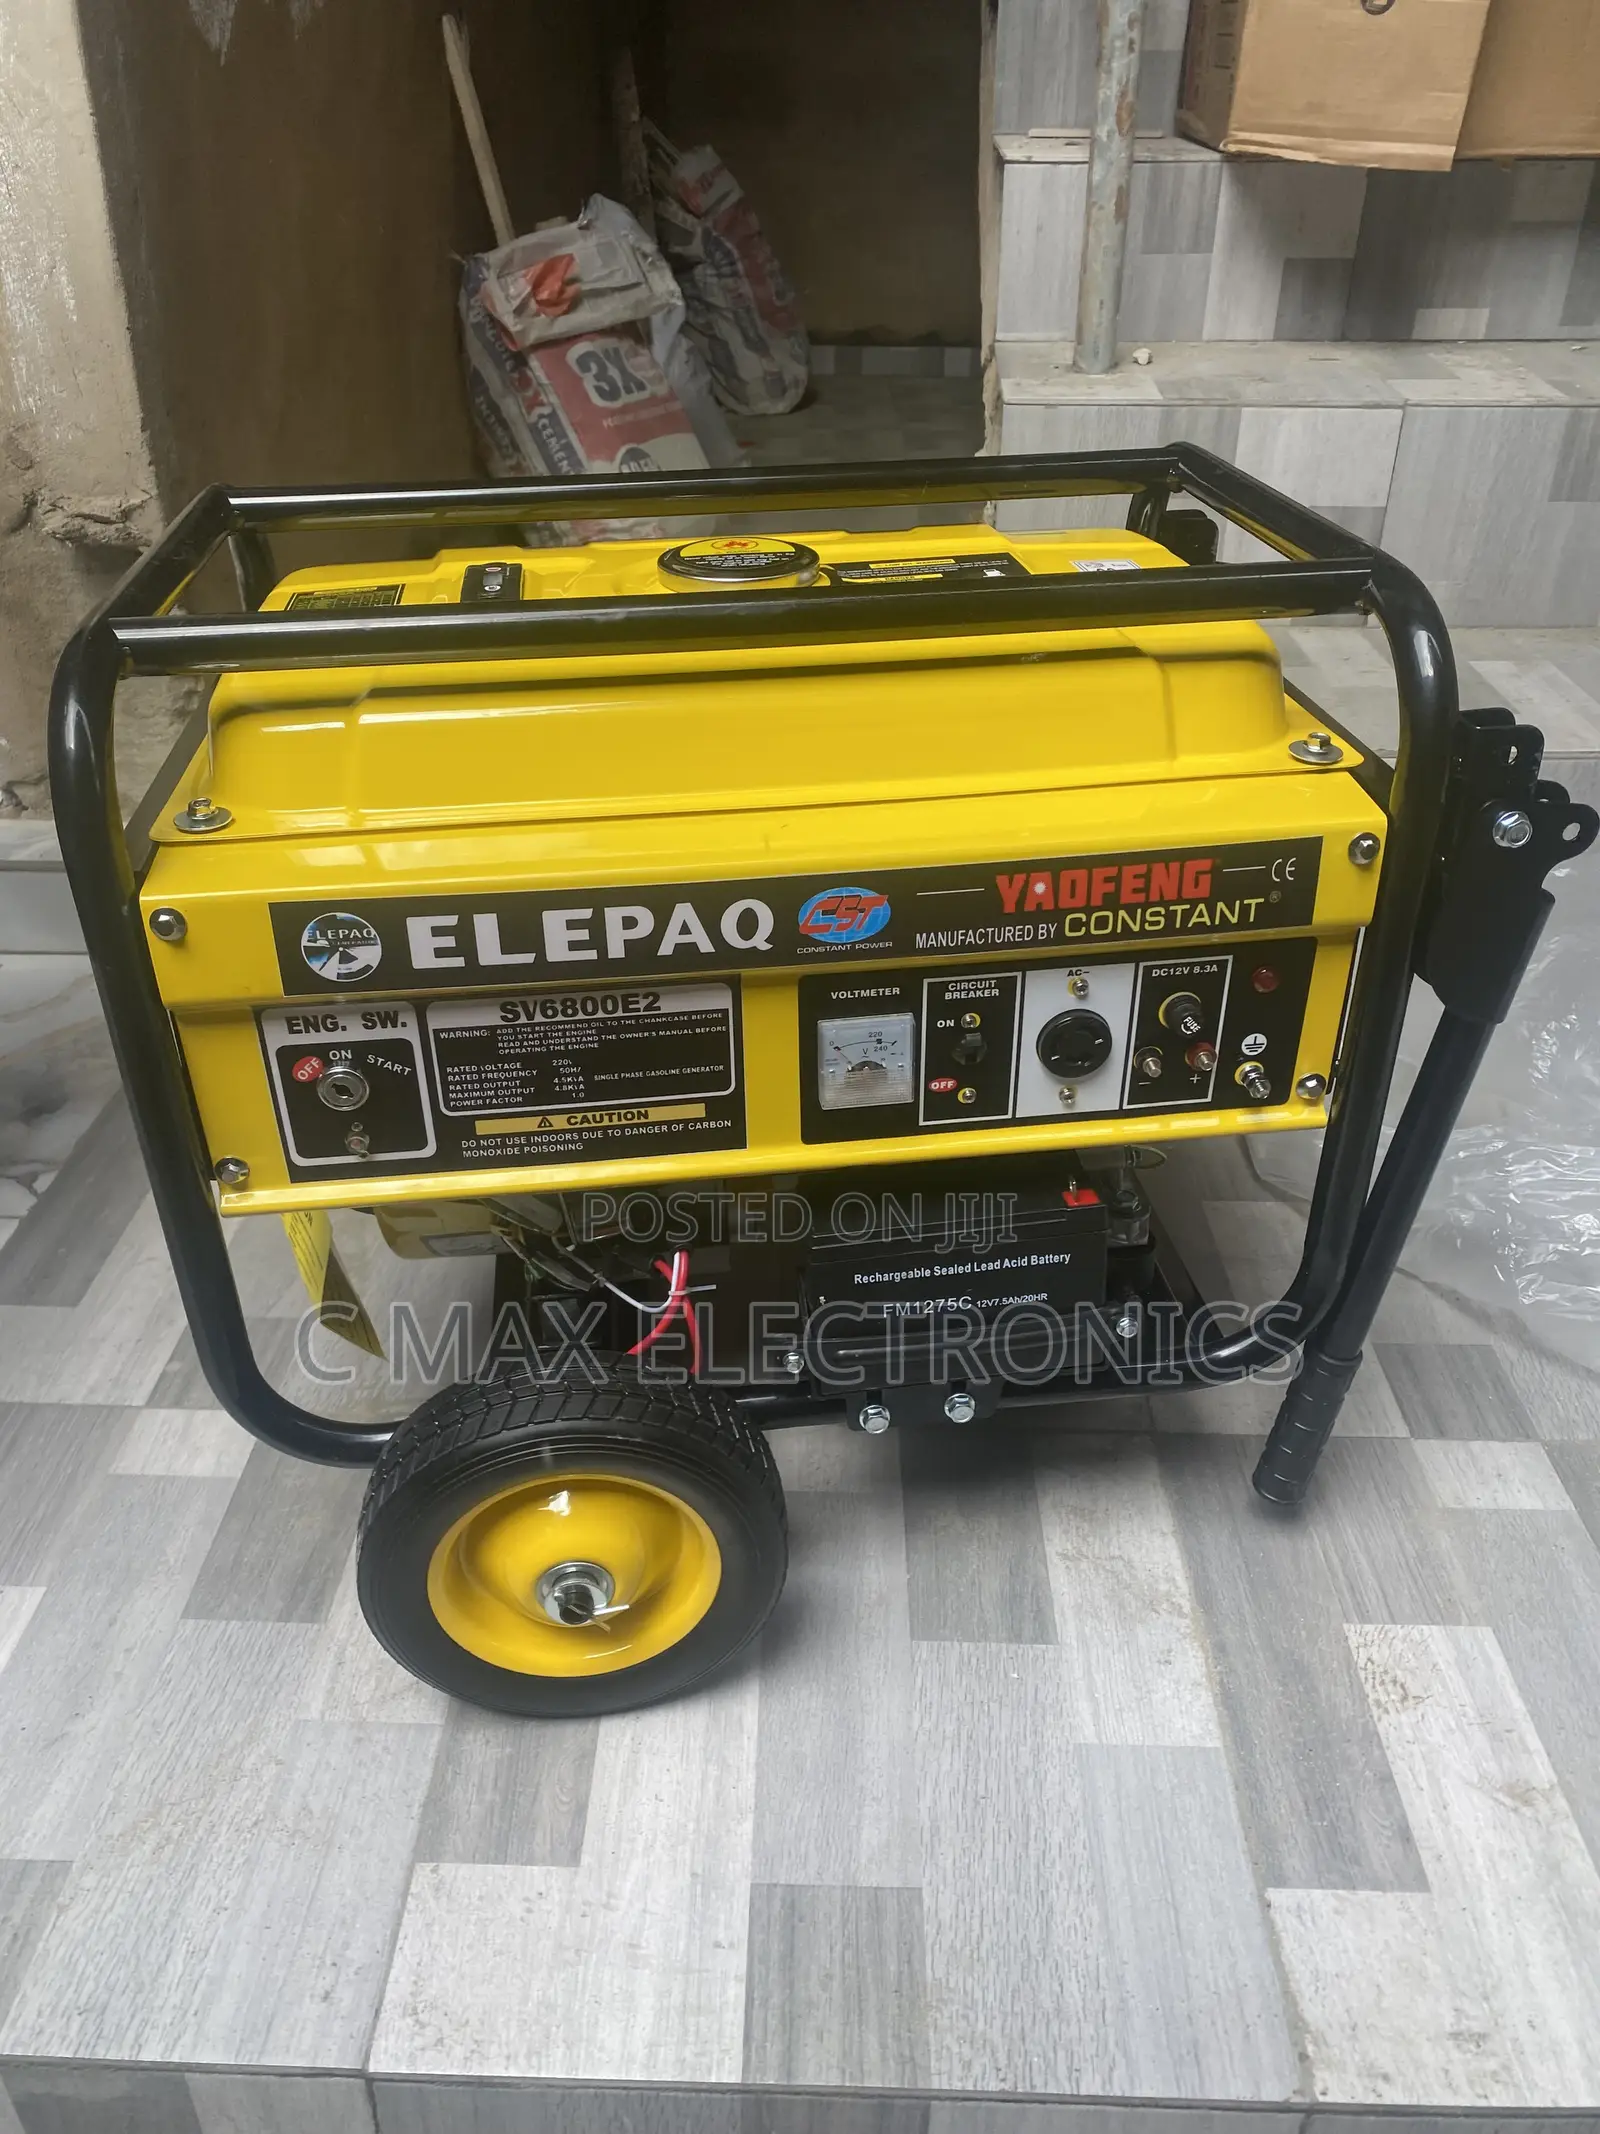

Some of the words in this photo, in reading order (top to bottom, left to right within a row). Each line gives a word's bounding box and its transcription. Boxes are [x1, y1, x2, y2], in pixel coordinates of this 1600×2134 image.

[575, 346, 649, 403] 3X
[995, 858, 1214, 914] YAOFENG
[798, 893, 889, 935] CST
[915, 925, 1034, 950] MANUFACTURED
[1036, 922, 1058, 941] BY
[1063, 898, 1265, 938] CONSTANT
[307, 927, 376, 940] ELEPAQ
[405, 898, 776, 971] ELEPAQ
[796, 944, 852, 954] CONSTANT
[855, 941, 893, 950] POWER
[1152, 966, 1190, 977] DC12V
[1193, 964, 1219, 974] 8.3A
[948, 979, 997, 991] CIRCUIT
[830, 987, 901, 1000] VOLTMETER
[944, 988, 1000, 1000] BREAKER
[499, 991, 662, 1023] SV6800E2
[285, 1014, 348, 1035] ENG.
[360, 1010, 408, 1030] SW.
[534, 1022, 589, 1032] RECOMMEND
[691, 1012, 723, 1021] BEFORE
[936, 1019, 955, 1028] ON
[1183, 1016, 1202, 1033] FUSE
[439, 1029, 491, 1040] WARNING:
[517, 1032, 544, 1040] START
[566, 1028, 597, 1037] ENGINE
[522, 1039, 540, 1047] AND
[542, 1035, 599, 1045] UNDERSTAND
[619, 1030, 657, 1039] OWNER'S
[658, 1028, 694, 1037] MANUAL
[695, 1025, 727, 1034] BEFORE
[328, 1049, 353, 1061] ON
[498, 1045, 547, 1055] OPERATING
[568, 1042, 600, 1050] ENGINE
[297, 1056, 321, 1081] OFF
[366, 1053, 413, 1077] START
[446, 1065, 478, 1074] RATED
[594, 1073, 619, 1081] SINGLE
[620, 1071, 644, 1079] PHASE
[645, 1068, 681, 1077] GASOLINE
[682, 1064, 725, 1074] GENERATOR
[447, 1074, 479, 1082] RATED
[481, 1069, 538, 1080] FREQUENCY
[449, 1083, 480, 1092] RATED
[482, 1080, 521, 1090] OUTPUT
[449, 1090, 496, 1100] MAXIMUM
[497, 1087, 536, 1096] OUTPUT
[931, 1081, 954, 1090] OFF
[450, 1099, 484, 1108] POWER
[485, 1096, 523, 1105] FACTOR
[566, 1109, 649, 1126] CAUTION
[461, 1140, 477, 1149] DO
[480, 1138, 502, 1147] NOT
[505, 1136, 528, 1145] USE
[530, 1132, 579, 1143] INDOORS
[582, 1130, 604, 1139] DUE
[607, 1129, 622, 1137] TO
[624, 1124, 668, 1136] DANGER
[671, 1123, 685, 1132] OF
[688, 1120, 732, 1130] CARBON
[462, 1147, 521, 1158] MONOXIDE
[524, 1142, 584, 1154] POISONING
[854, 1267, 931, 1284] Rechargeable
[933, 1263, 972, 1276] Sealed
[973, 1259, 1001, 1272] Lead
[1002, 1256, 1028, 1269] Acid
[1030, 1253, 1071, 1267] Battery
[882, 1296, 973, 1318] FM1275C
